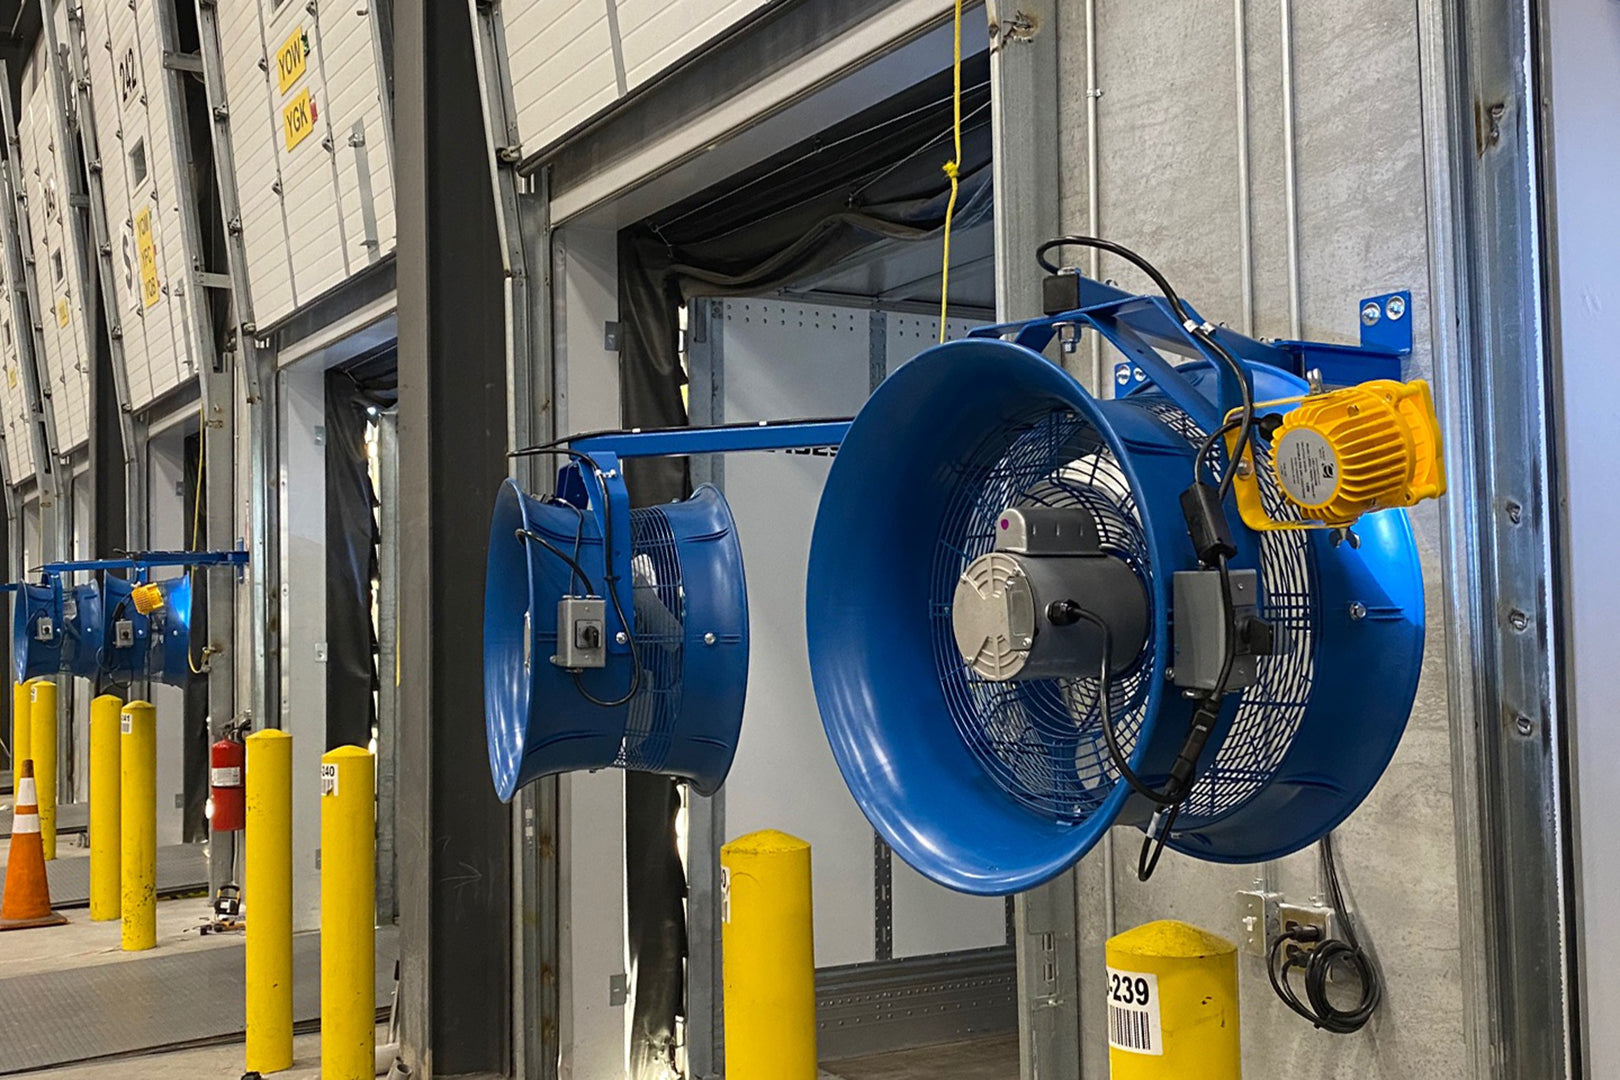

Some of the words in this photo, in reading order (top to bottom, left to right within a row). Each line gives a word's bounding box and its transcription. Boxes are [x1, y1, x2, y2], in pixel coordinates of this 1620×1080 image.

[119, 47, 137, 103] 242
[279, 37, 301, 80] YOW
[286, 98, 309, 138] YGK
[1107, 970, 1150, 1006] -239
